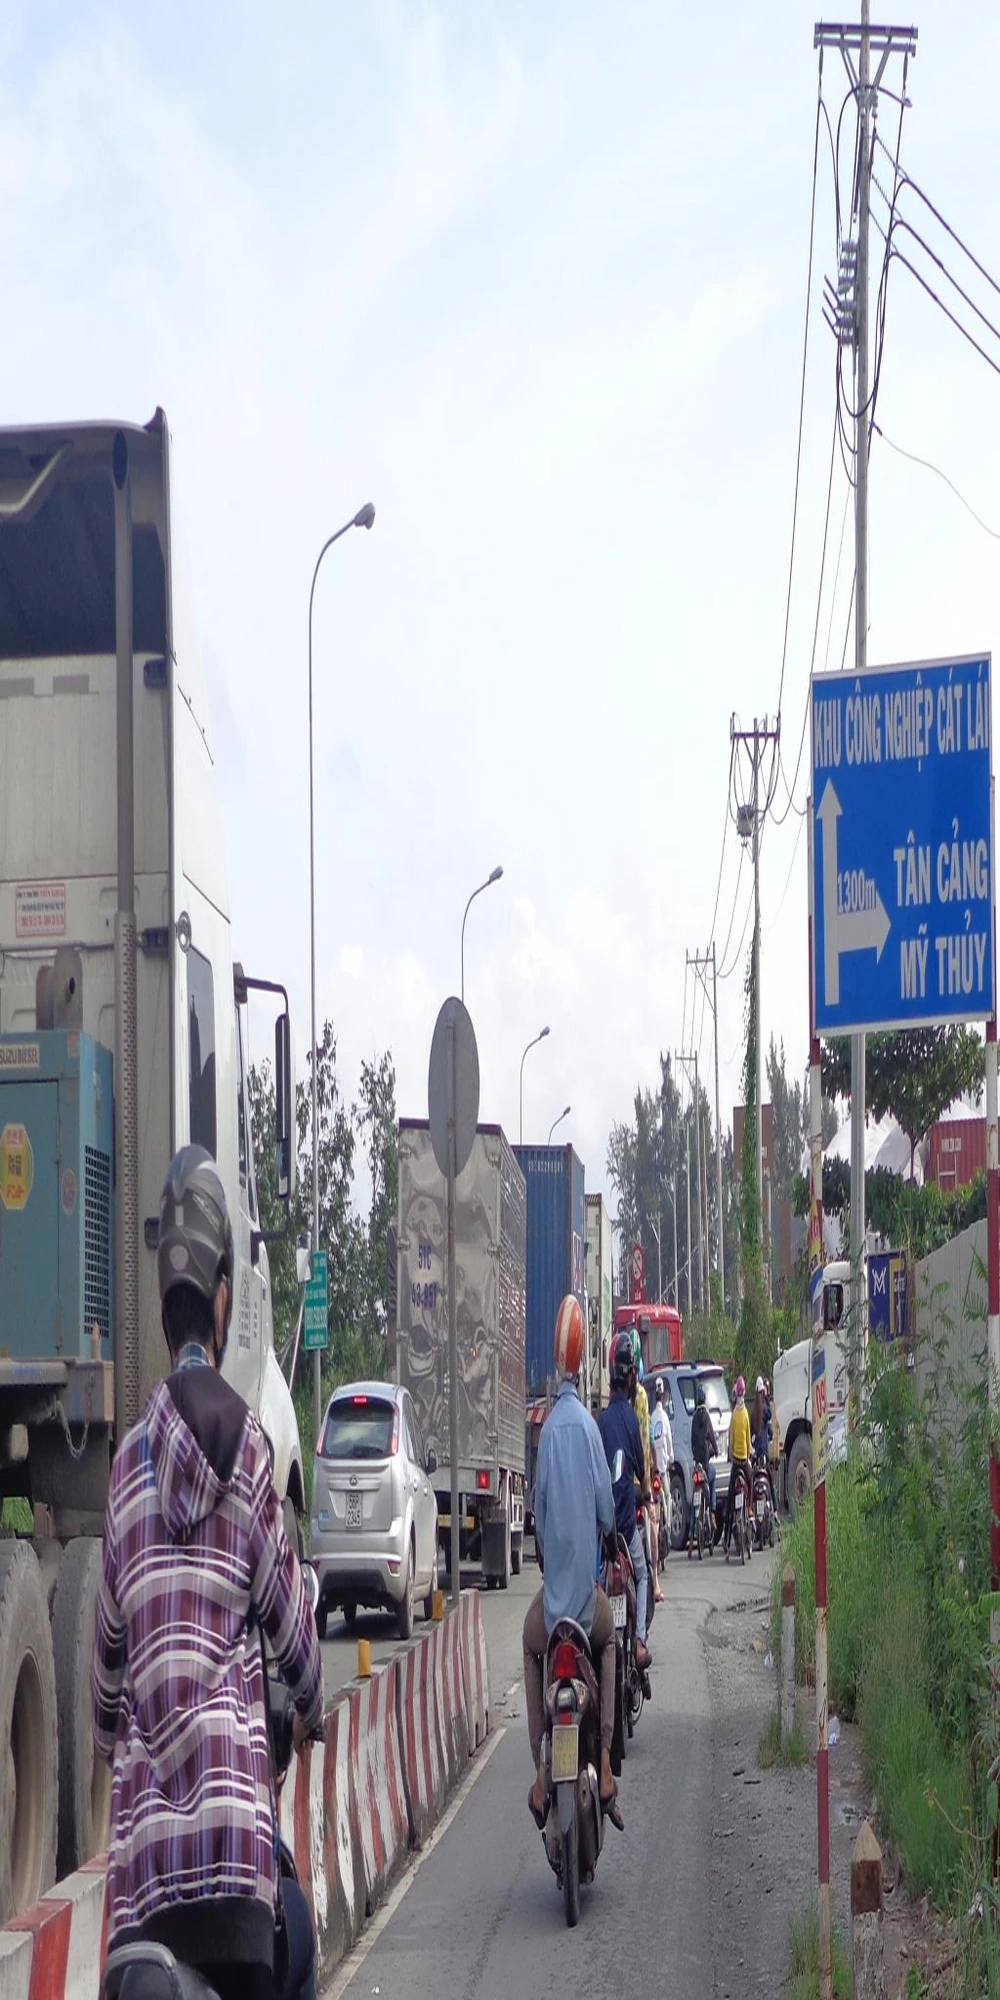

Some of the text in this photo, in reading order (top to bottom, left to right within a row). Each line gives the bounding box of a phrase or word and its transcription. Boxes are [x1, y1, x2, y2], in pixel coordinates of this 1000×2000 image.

[814, 663, 989, 773] KHU CÔNG NGHIỆP CÁT LÁI
[837, 867, 877, 914] 1300m
[893, 816, 988, 907] TÂN CẢNG
[900, 908, 988, 1000] MỸ THỦY
